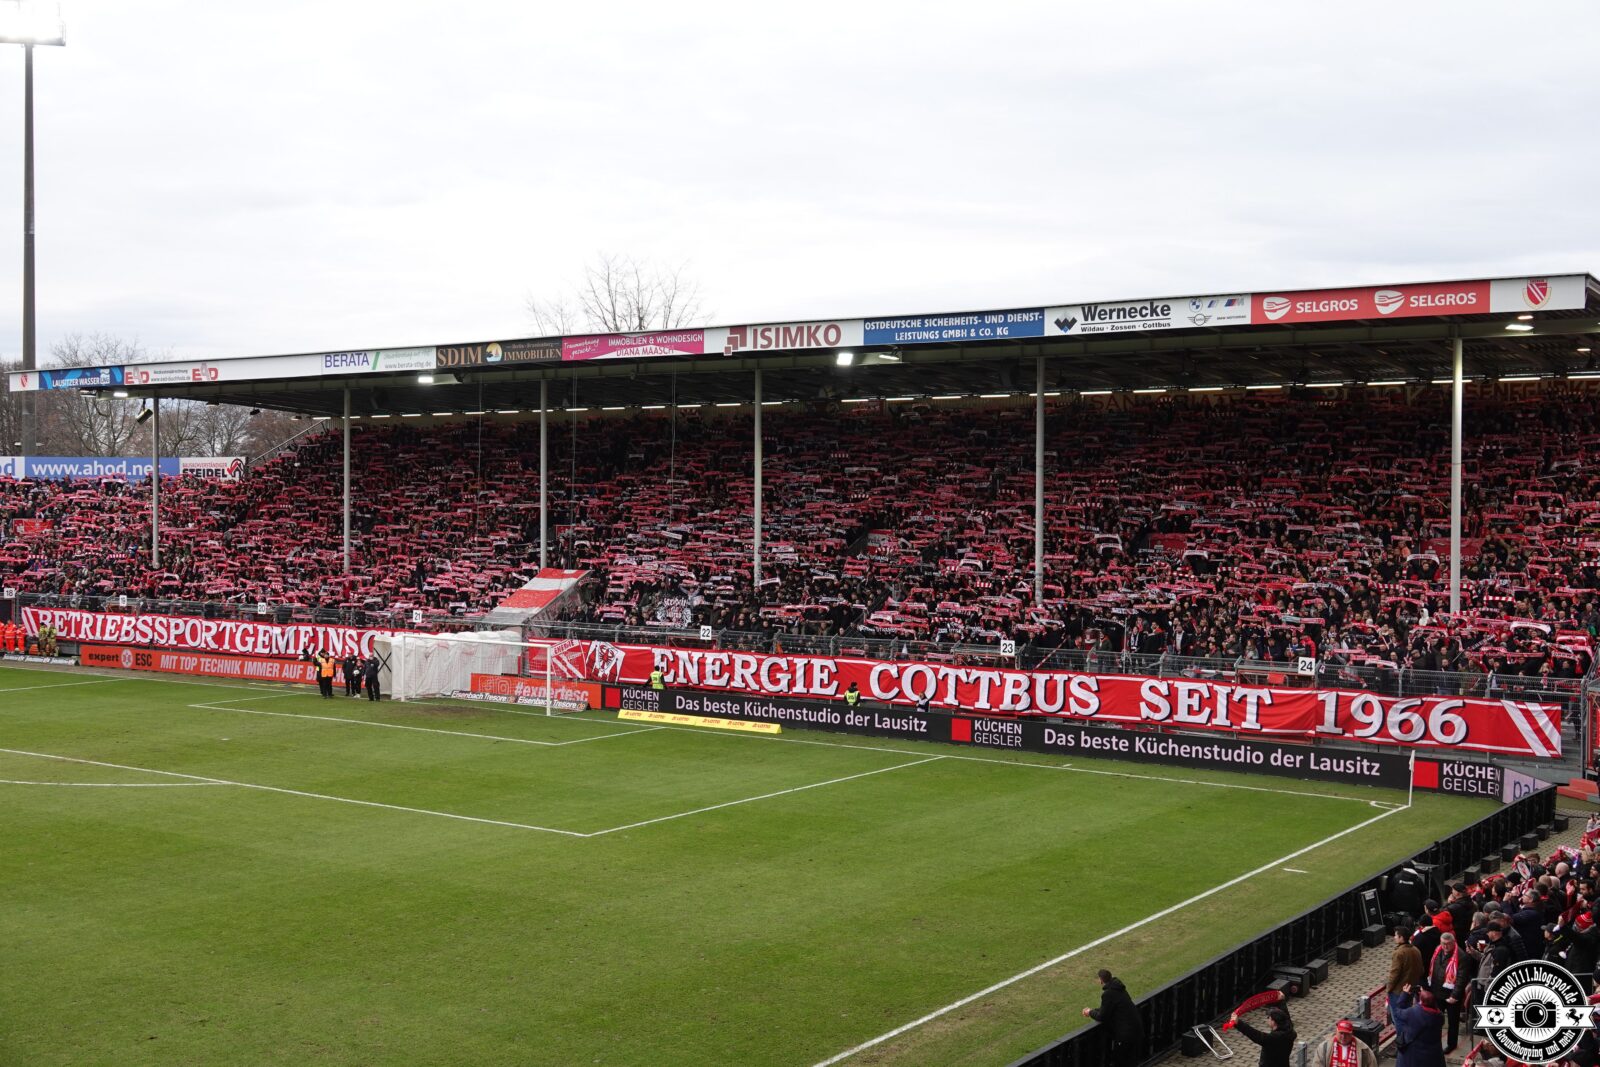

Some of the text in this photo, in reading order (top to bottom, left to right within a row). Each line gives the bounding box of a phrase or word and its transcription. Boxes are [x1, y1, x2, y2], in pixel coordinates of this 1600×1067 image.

[1296, 299, 1358, 314] SELGROS
[1410, 292, 1477, 308] SELGROS
[1081, 304, 1171, 322] Wernecke
[865, 312, 1043, 331] OSTDEUTSCHE SICHERHEITS- UND DIENST-
[1081, 325, 1104, 333] Wildau
[1142, 321, 1171, 329] Cottbus
[608, 333, 703, 347] IMMOBILIEN & WOHNDESIGN
[752, 323, 842, 350] ISIMKO
[895, 326, 1009, 341] LEISTUNGS GMBH & CO. KG
[437, 346, 482, 367] SDIM
[504, 348, 562, 361] IMMOBILIEN
[617, 345, 674, 357] DIANA MAASCH
[325, 352, 370, 368] BERATA
[53, 379, 78, 388] LAUSITZER
[79, 377, 100, 386] WASSER
[32, 460, 161, 476] www.ahod.ne
[5, 589, 13, 597] 18
[258, 604, 266, 613] 20
[414, 613, 421, 621] 21
[38, 609, 402, 659] BETRIEBSSPORTGEMEINSC
[702, 628, 711, 638] 22
[1002, 643, 1014, 654] 23
[88, 652, 119, 663] expert
[135, 653, 153, 667] ESC
[160, 654, 178, 670] MIT
[180, 656, 198, 671] TOP
[200, 657, 242, 675] TECHNIK
[243, 661, 280, 678] IMMER
[282, 663, 304, 680] AUF
[1300, 660, 1314, 672] 24
[451, 691, 484, 700] Eisenbach
[622, 686, 660, 702] KÜCHEN
[651, 649, 1469, 745] ENERGIE COTTBUS SEIT 1966
[622, 699, 660, 712] GEISLER
[675, 695, 928, 733] Das beste Küchenstudio der Lausitz
[974, 718, 1023, 736] KÜCHEN
[974, 731, 1022, 748] GEISLER
[1044, 728, 1380, 777] Das beste Küchenstudio der Lausitz
[1443, 761, 1501, 782] KÜCHEN
[1442, 777, 1500, 796] GEISLER
